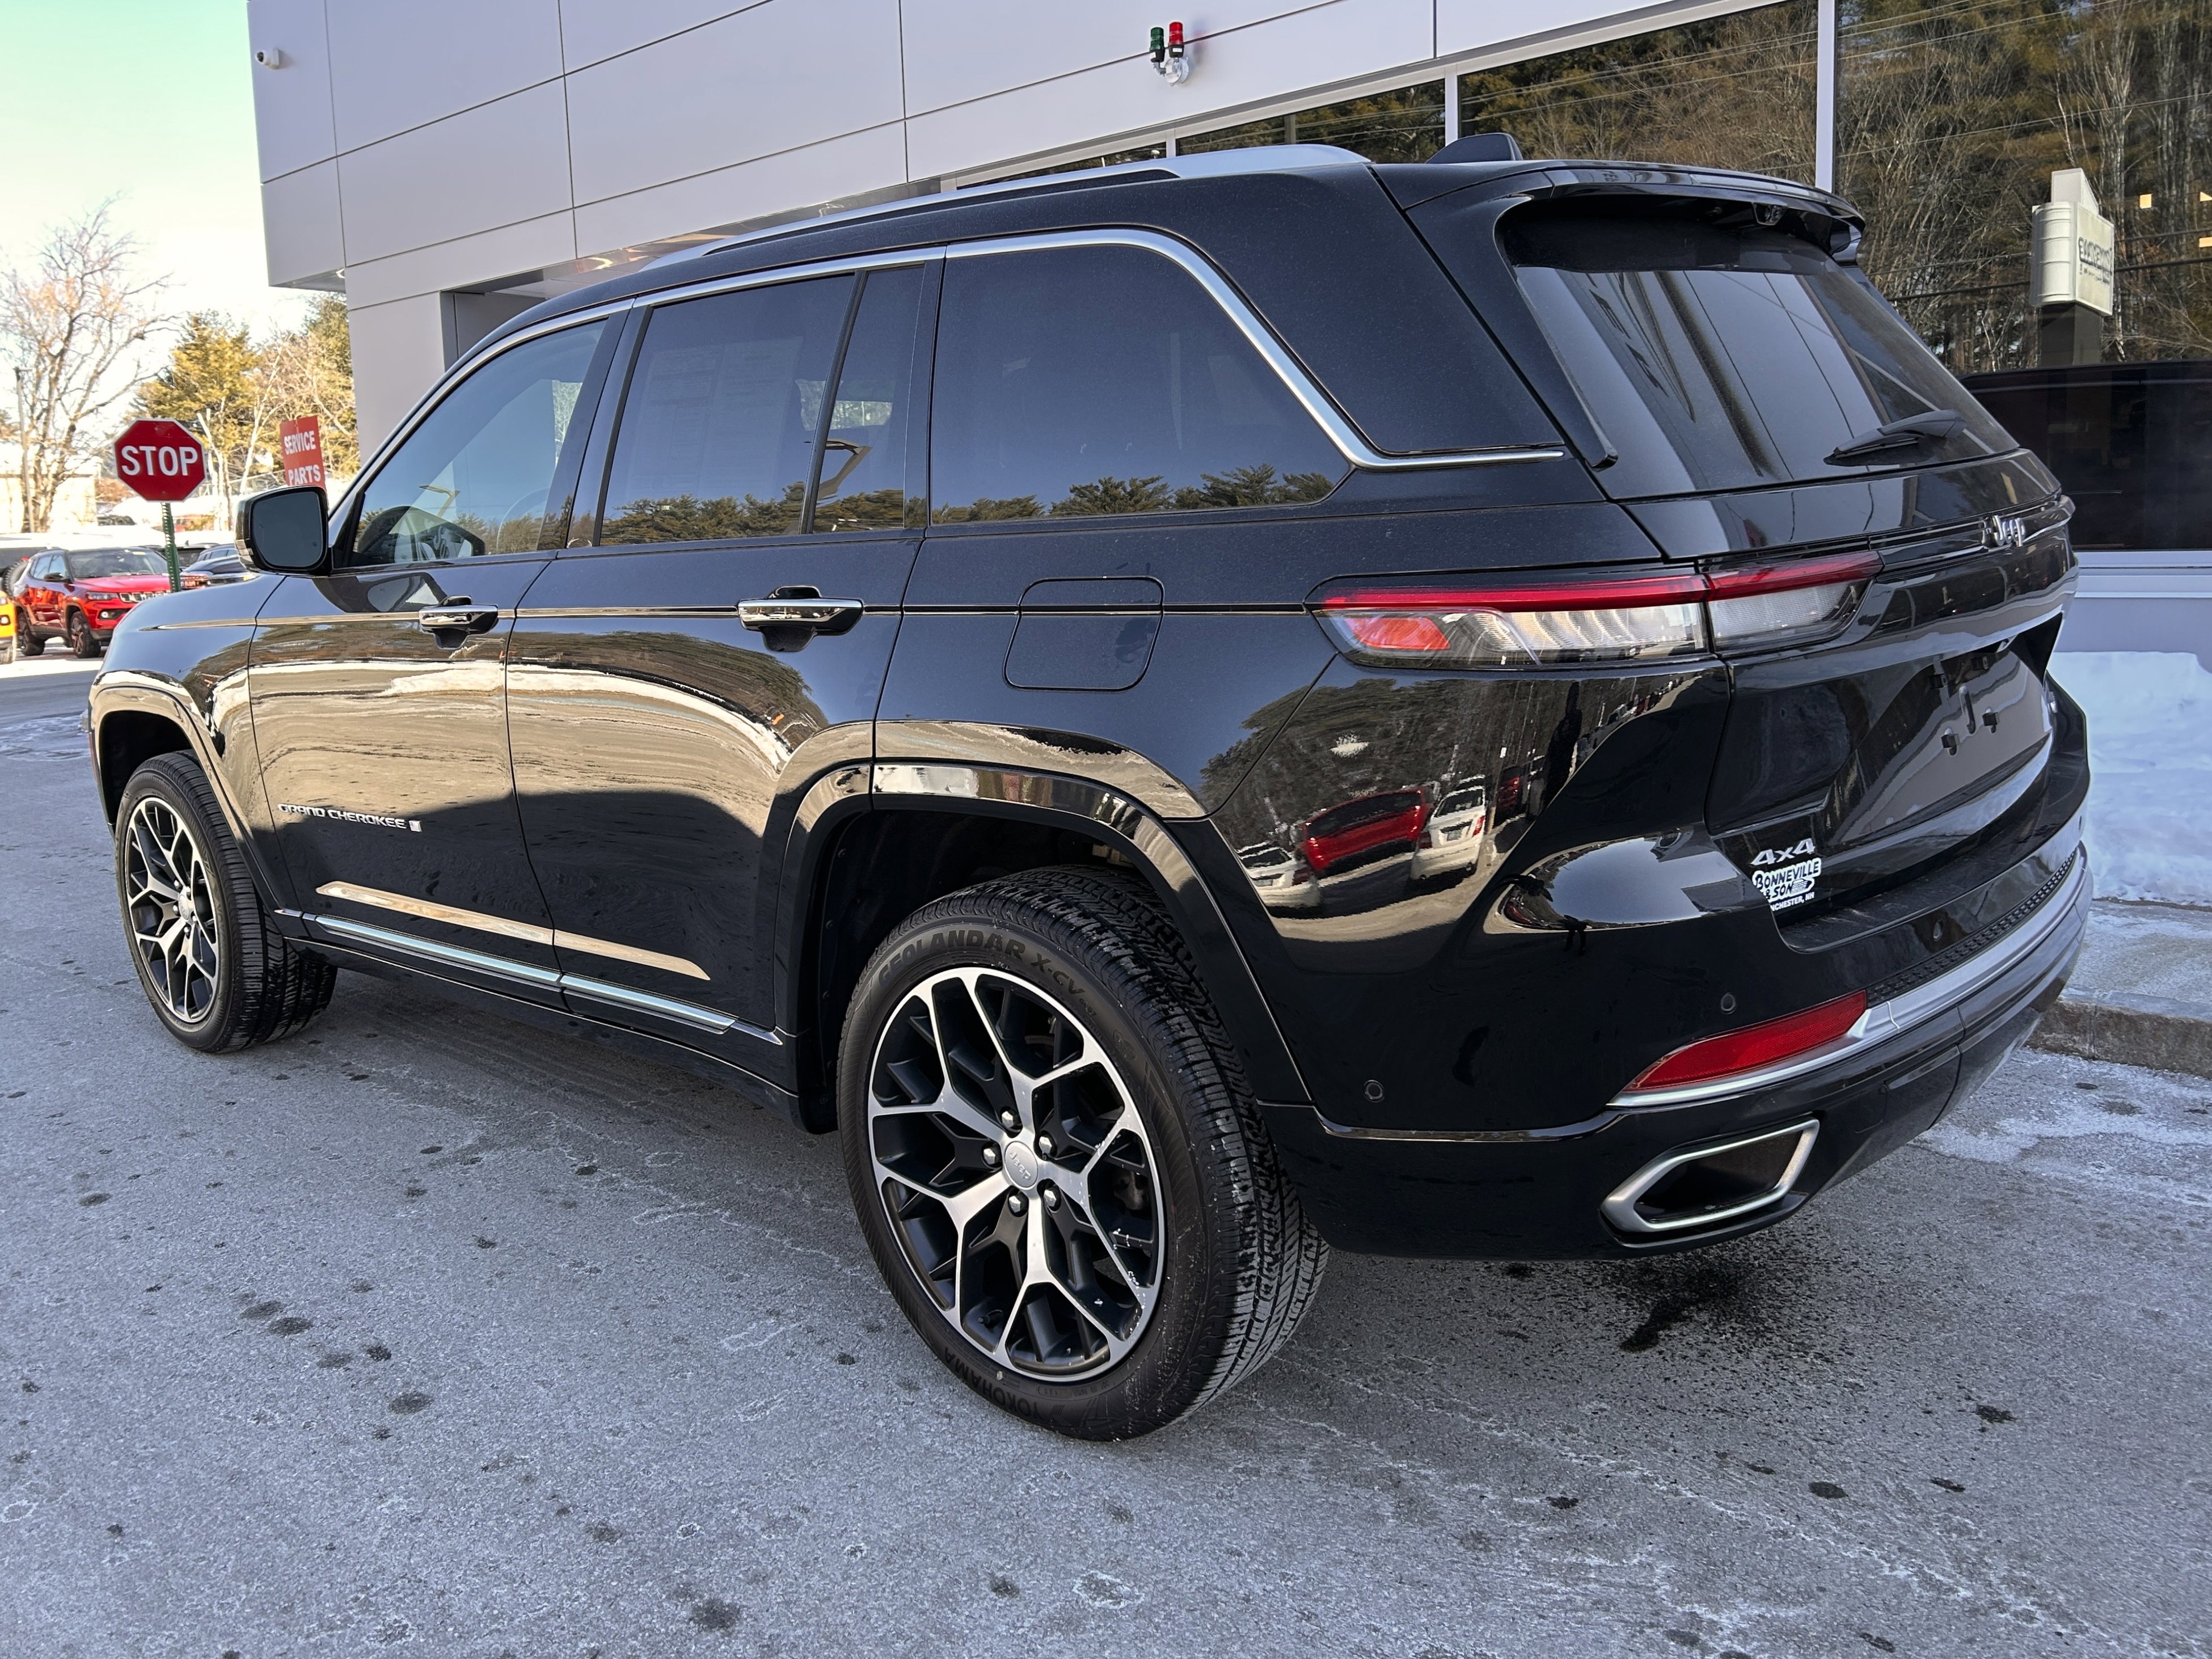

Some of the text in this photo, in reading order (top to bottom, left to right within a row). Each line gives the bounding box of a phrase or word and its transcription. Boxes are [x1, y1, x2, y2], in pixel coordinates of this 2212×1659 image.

[284, 430, 316, 455] SERVICE
[121, 445, 198, 476] STOP
[288, 465, 321, 486] PARTS
[277, 804, 407, 829] GRAND CHEROKEE
[1750, 838, 1816, 866] 4x4
[1754, 859, 1820, 890] BONNEVILLE
[1770, 892, 1815, 911] NCHESTER, NH
[1771, 883, 1794, 898] SON
[879, 929, 1026, 986] GEOLANDAR
[1031, 952, 1086, 994] X-CV
[1009, 1151, 1032, 1180] Jeep
[944, 1346, 1045, 1422] YOKOHAMA
